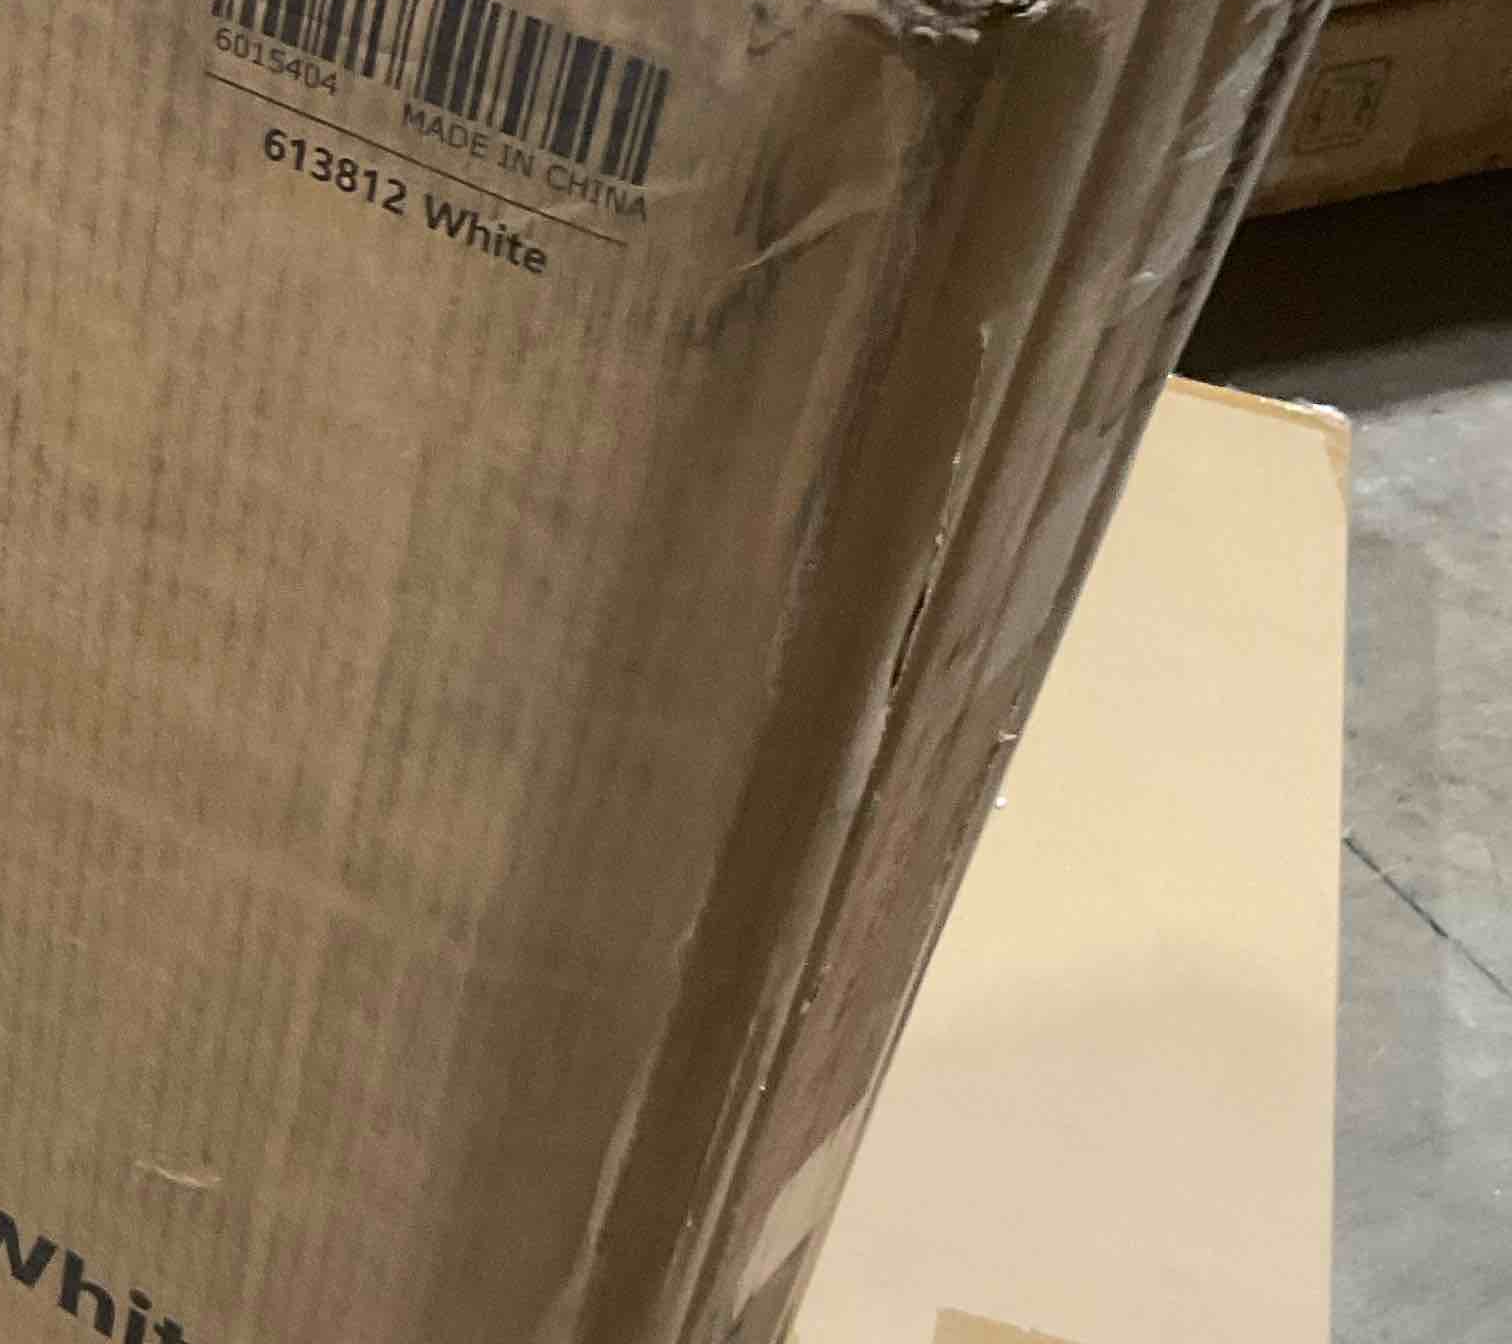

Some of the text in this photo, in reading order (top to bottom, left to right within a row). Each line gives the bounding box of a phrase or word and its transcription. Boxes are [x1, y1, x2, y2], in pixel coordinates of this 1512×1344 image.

[214, 27, 338, 97] 6015404
[263, 128, 549, 275] 613812 White
[402, 103, 648, 222] MADE IN CHINA
